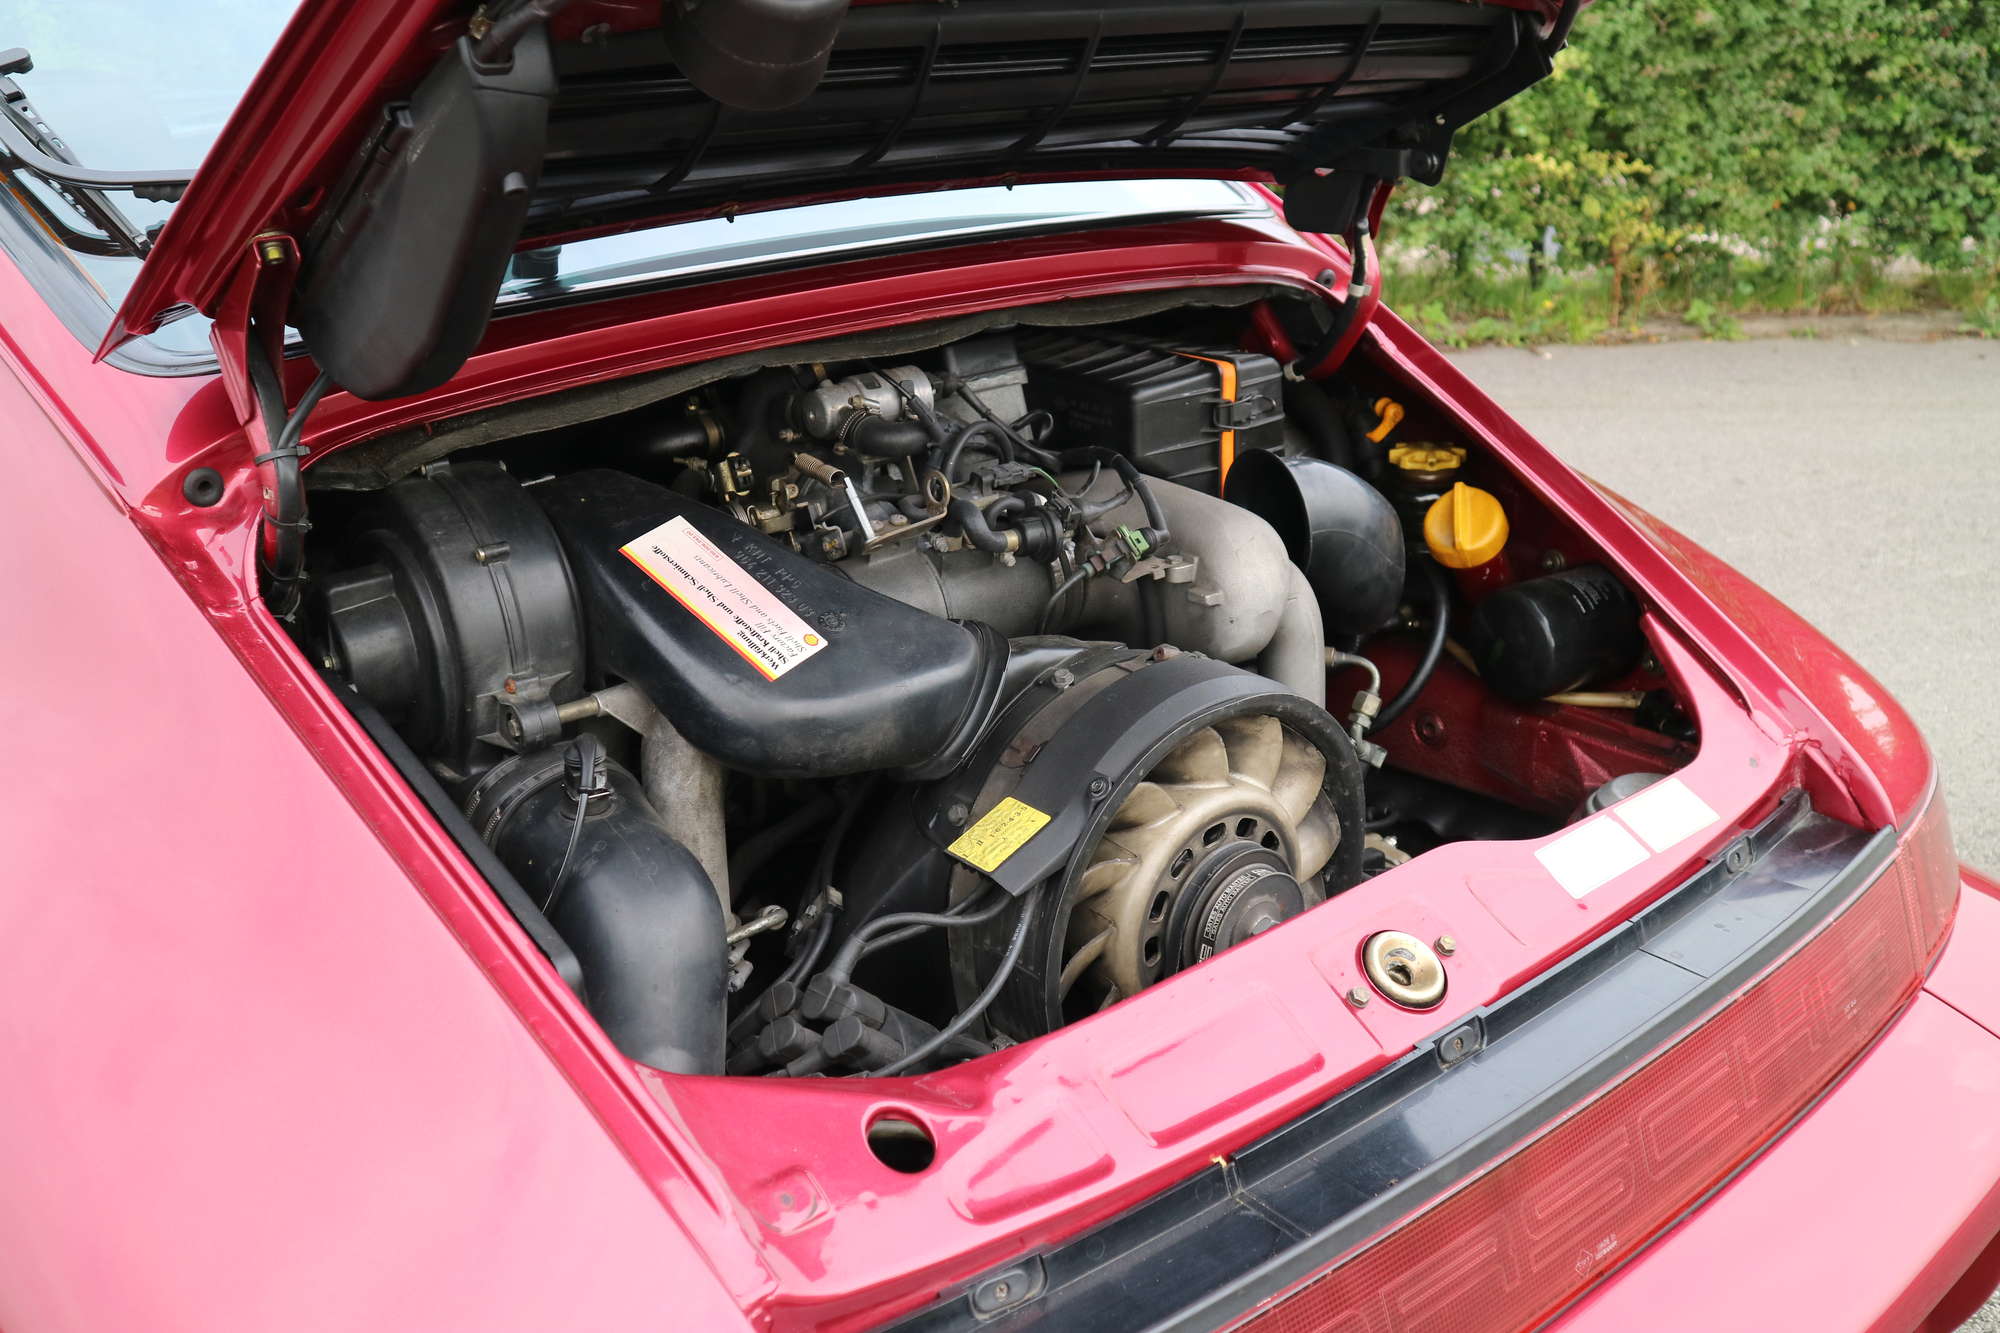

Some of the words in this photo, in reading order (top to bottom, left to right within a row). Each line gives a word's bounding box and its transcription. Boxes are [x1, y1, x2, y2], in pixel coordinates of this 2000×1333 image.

[652, 545, 698, 586] Schmierstoffe
[693, 555, 733, 588] Lubricants
[696, 584, 719, 603] Shell
[729, 586, 753, 605] Shell
[717, 601, 734, 615] und
[748, 604, 768, 618] and
[733, 614, 770, 648] Kraftstoffe
[754, 622, 771, 634] Fill
[767, 617, 789, 637] Fuels
[773, 634, 798, 658] Factory
[784, 635, 808, 653] Shell
[768, 645, 789, 665] Shell
